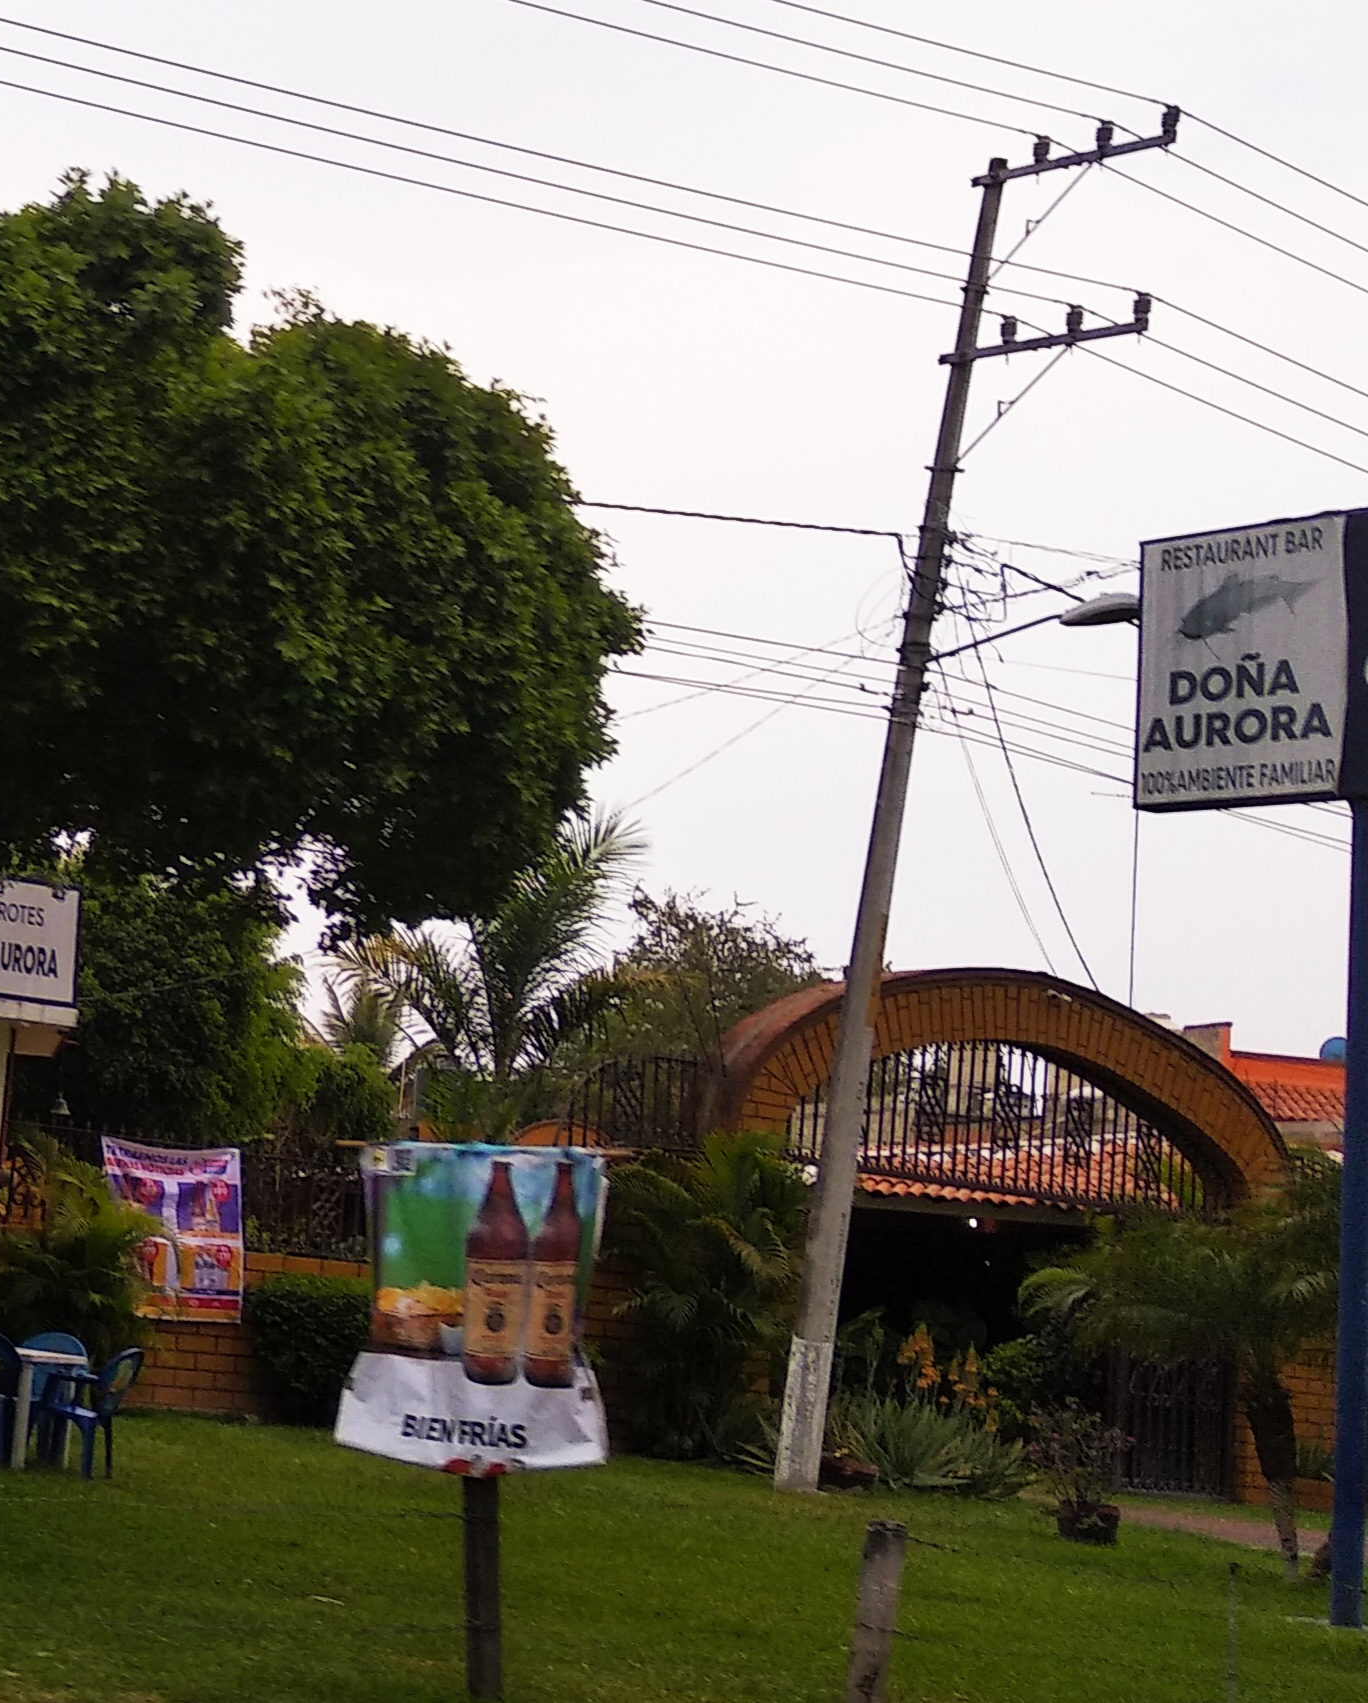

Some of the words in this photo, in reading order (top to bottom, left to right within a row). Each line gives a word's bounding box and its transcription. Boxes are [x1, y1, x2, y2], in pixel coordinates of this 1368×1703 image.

[1160, 533, 1280, 572] RESTAURANT
[1285, 526, 1324, 553] BAR
[1169, 652, 1300, 706] DOÑA
[1143, 703, 1333, 752] AURORA
[1259, 758, 1336, 788] FAMILIAR
